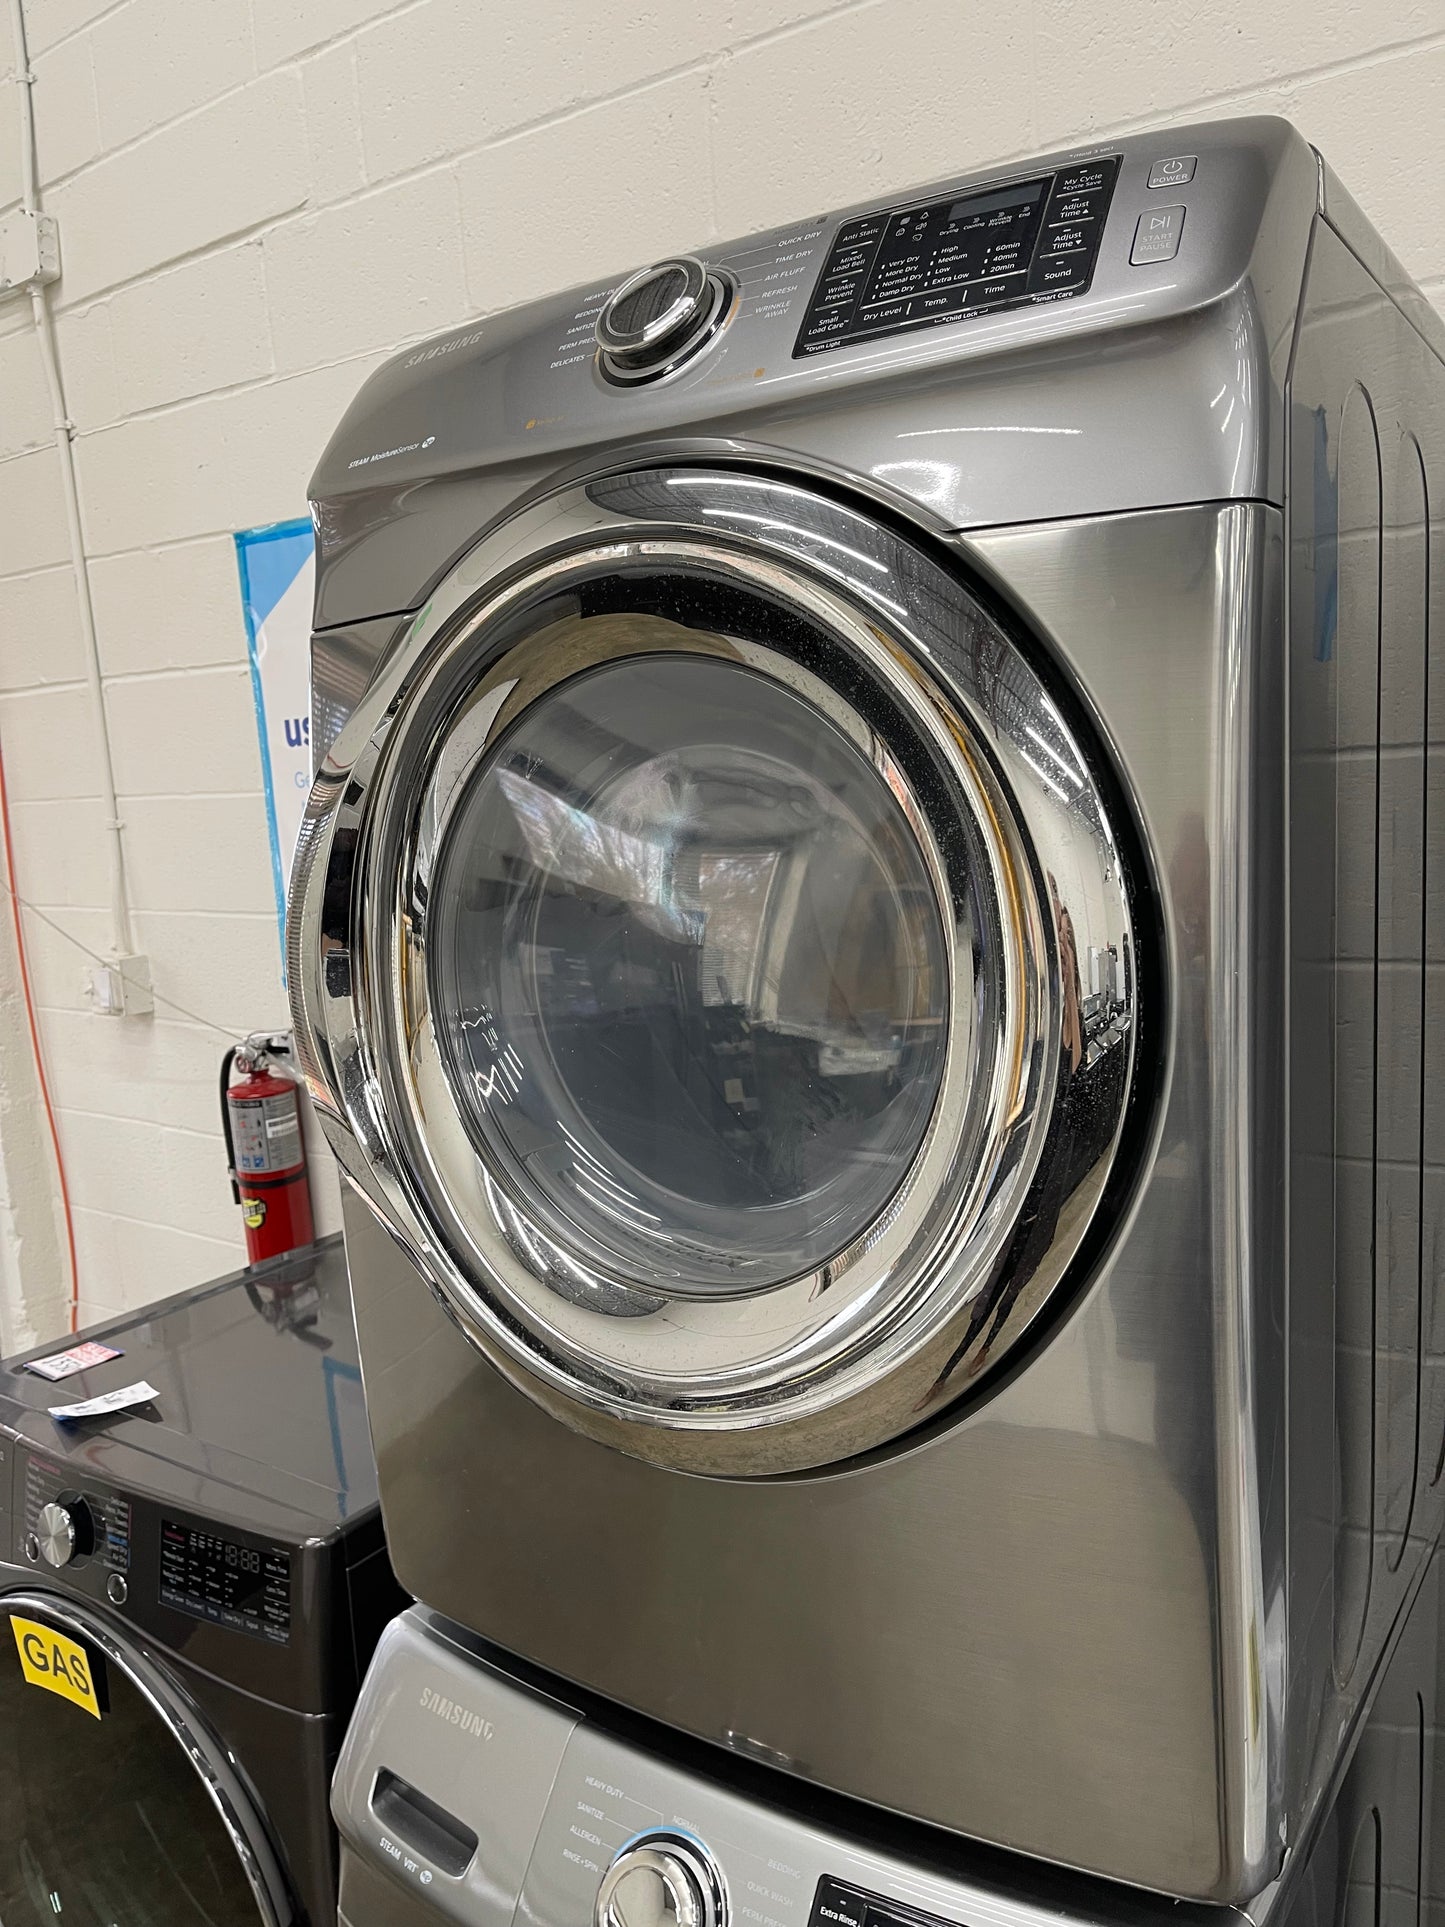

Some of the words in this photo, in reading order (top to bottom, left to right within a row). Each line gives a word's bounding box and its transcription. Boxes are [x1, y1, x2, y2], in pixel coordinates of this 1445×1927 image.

[1080, 174, 1103, 183] Cycle
[1152, 173, 1188, 184] POWER
[1062, 200, 1090, 212] Adjust
[1060, 209, 1081, 218] Time
[939, 228, 959, 236] Drying
[963, 222, 986, 230] Cooling
[778, 235, 802, 247] QUICK
[804, 231, 822, 240] DRY
[842, 232, 858, 242] Anti
[860, 227, 880, 238] Static
[1054, 232, 1082, 243] Adjust
[1141, 232, 1173, 243] START
[940, 245, 959, 255] High
[995, 242, 1021, 252] 60min
[1052, 240, 1074, 250] Time
[1140, 242, 1172, 252] PAUSE
[775, 253, 795, 264] TIME
[796, 249, 814, 259] DRY
[840, 253, 864, 264] Mixed
[888, 259, 906, 269] Very
[906, 254, 920, 265] Dry
[938, 252, 968, 264] Medium
[992, 252, 1018, 262] 40min
[832, 262, 850, 273] Load
[851, 258, 866, 268] Bell
[885, 269, 904, 278] More
[904, 264, 919, 274] Dry
[934, 266, 951, 275] Low
[990, 262, 1015, 273] 20min
[764, 273, 779, 282] AIR
[780, 266, 806, 278] FLUFF
[882, 276, 909, 288] Normal
[910, 272, 924, 282] Dry
[931, 276, 952, 286] Extra
[953, 272, 970, 281] Low
[1044, 269, 1072, 280] Sound
[762, 285, 798, 298] REFRESH
[827, 282, 856, 294] Wrinkle
[879, 288, 900, 298] Damp
[900, 284, 915, 294] Dry
[984, 285, 1006, 294] Time
[1057, 290, 1074, 298] Care
[584, 291, 607, 302] HEAVY
[824, 290, 854, 302] Prevent
[755, 300, 792, 314] WRINKLE
[924, 297, 948, 308] Temp.
[764, 308, 790, 319] AWAY
[863, 312, 879, 322] Dry
[880, 306, 903, 318] Level
[963, 310, 979, 319] Lock
[818, 315, 840, 326] Small
[566, 321, 597, 335] SANITIZE
[808, 326, 826, 336] Load
[404, 331, 484, 369] SAMSUNG
[558, 342, 578, 352] PERM
[826, 340, 842, 350] Light
[550, 354, 586, 369] DELICATES
[348, 456, 370, 469] STEAM
[23, 1632, 90, 1696] GAS
[420, 1687, 495, 1742] SAMSUNG
[584, 1776, 606, 1792] HEAVY
[606, 1785, 625, 1799] DUTY
[577, 1801, 605, 1820] SANITIZE
[570, 1824, 602, 1846] ALLERGEN
[380, 1837, 402, 1860] STEAM
[767, 1858, 800, 1879] BEDDING
[746, 1881, 770, 1898] QUICK
[770, 1889, 793, 1908] WASH
[820, 1906, 839, 1920] Extra
[839, 1913, 858, 1927] Rinse
